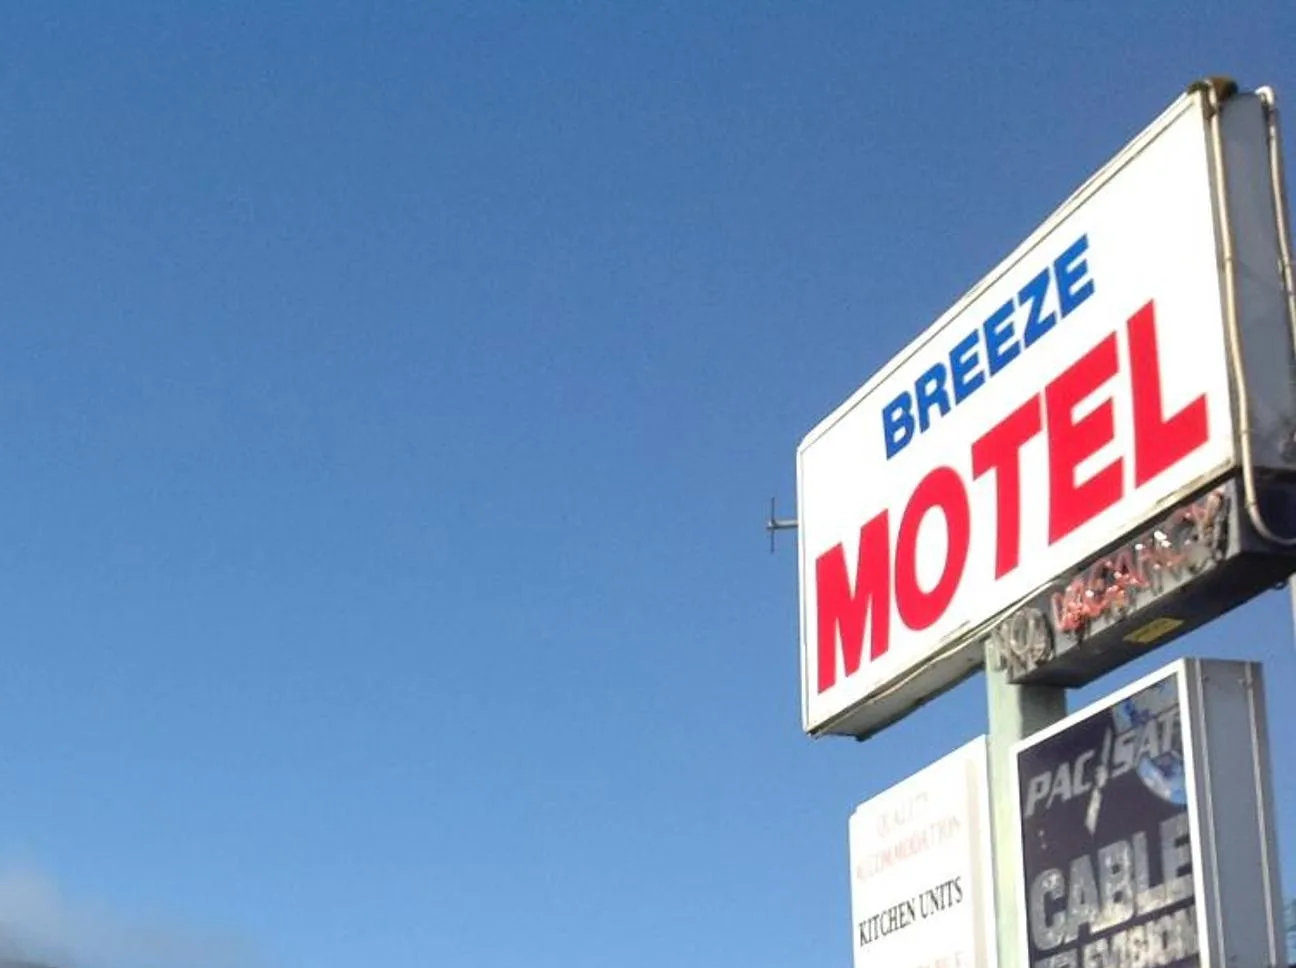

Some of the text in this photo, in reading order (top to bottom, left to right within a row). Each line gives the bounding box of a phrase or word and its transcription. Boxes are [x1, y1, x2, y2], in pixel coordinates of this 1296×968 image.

[882, 234, 1095, 460] BREEZE
[816, 299, 1209, 694] MOTEL
[990, 606, 1053, 680] NO
[858, 876, 964, 947] KITCHEN UNITS
[1029, 812, 1193, 951] CABLE
